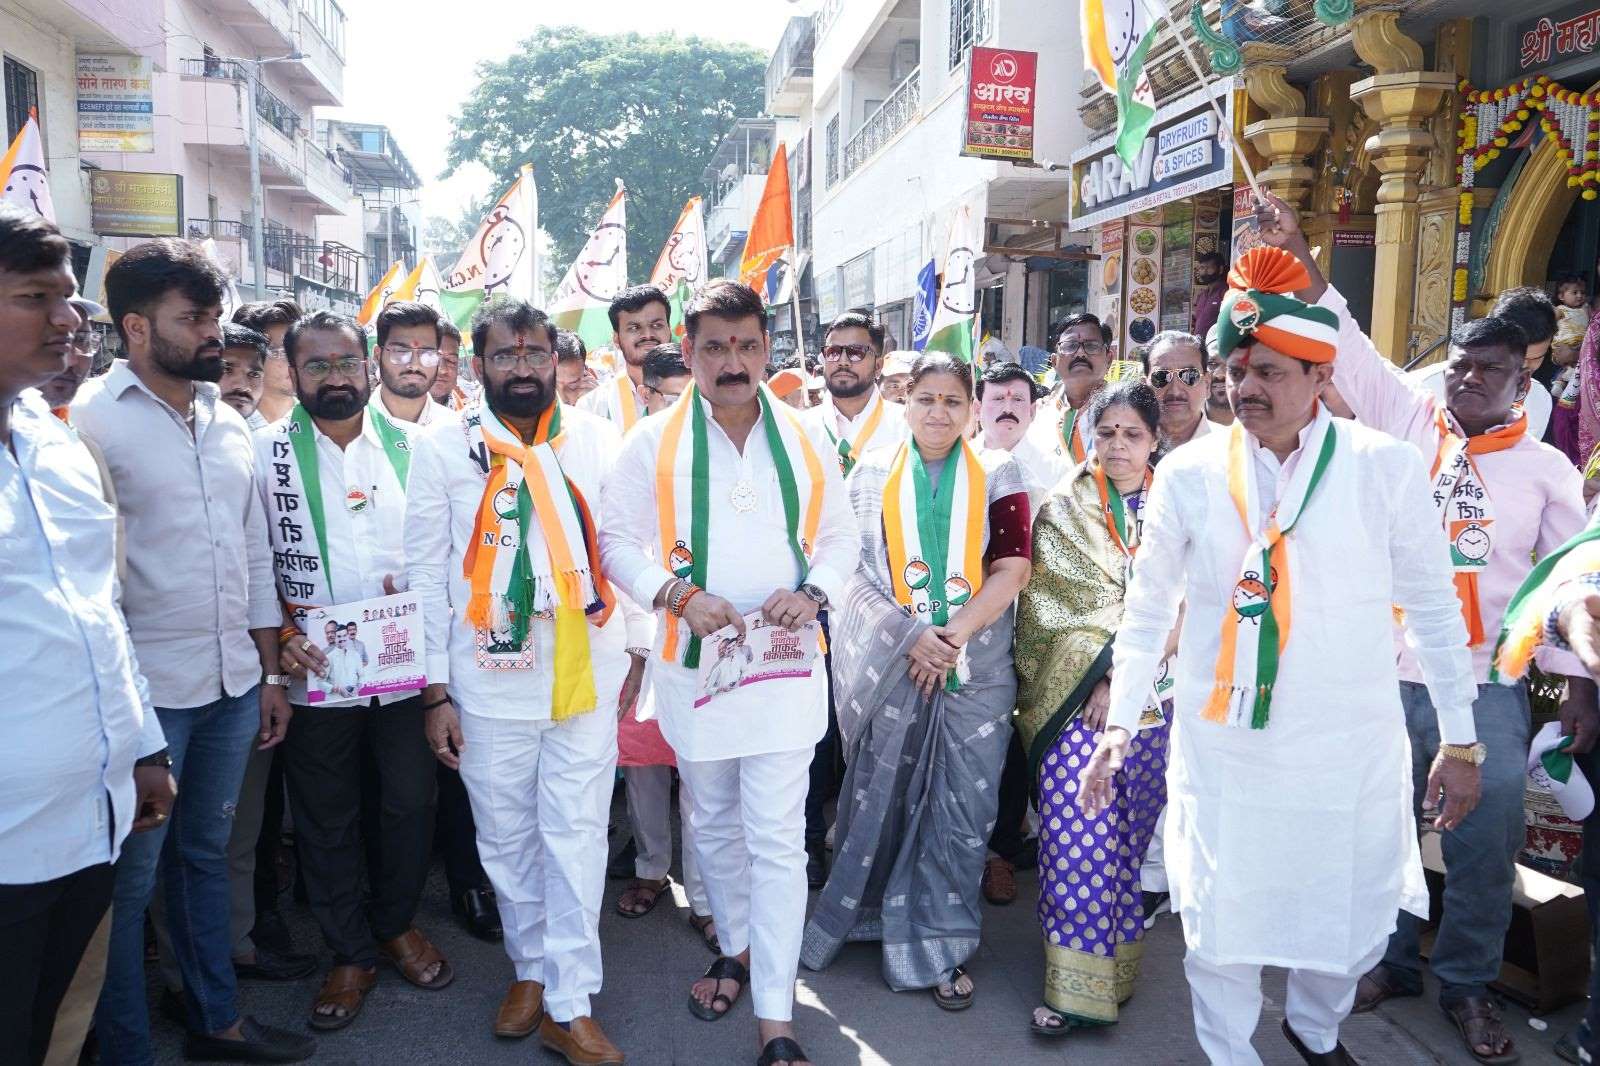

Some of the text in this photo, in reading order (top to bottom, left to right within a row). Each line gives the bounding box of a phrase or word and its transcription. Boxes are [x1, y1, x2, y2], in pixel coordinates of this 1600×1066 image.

[1520, 9, 1600, 68] श्री महा
[974, 82, 1031, 105] आरव
[1160, 117, 1208, 151] DRYFRUITS
[1164, 146, 1204, 174] & SPICES
